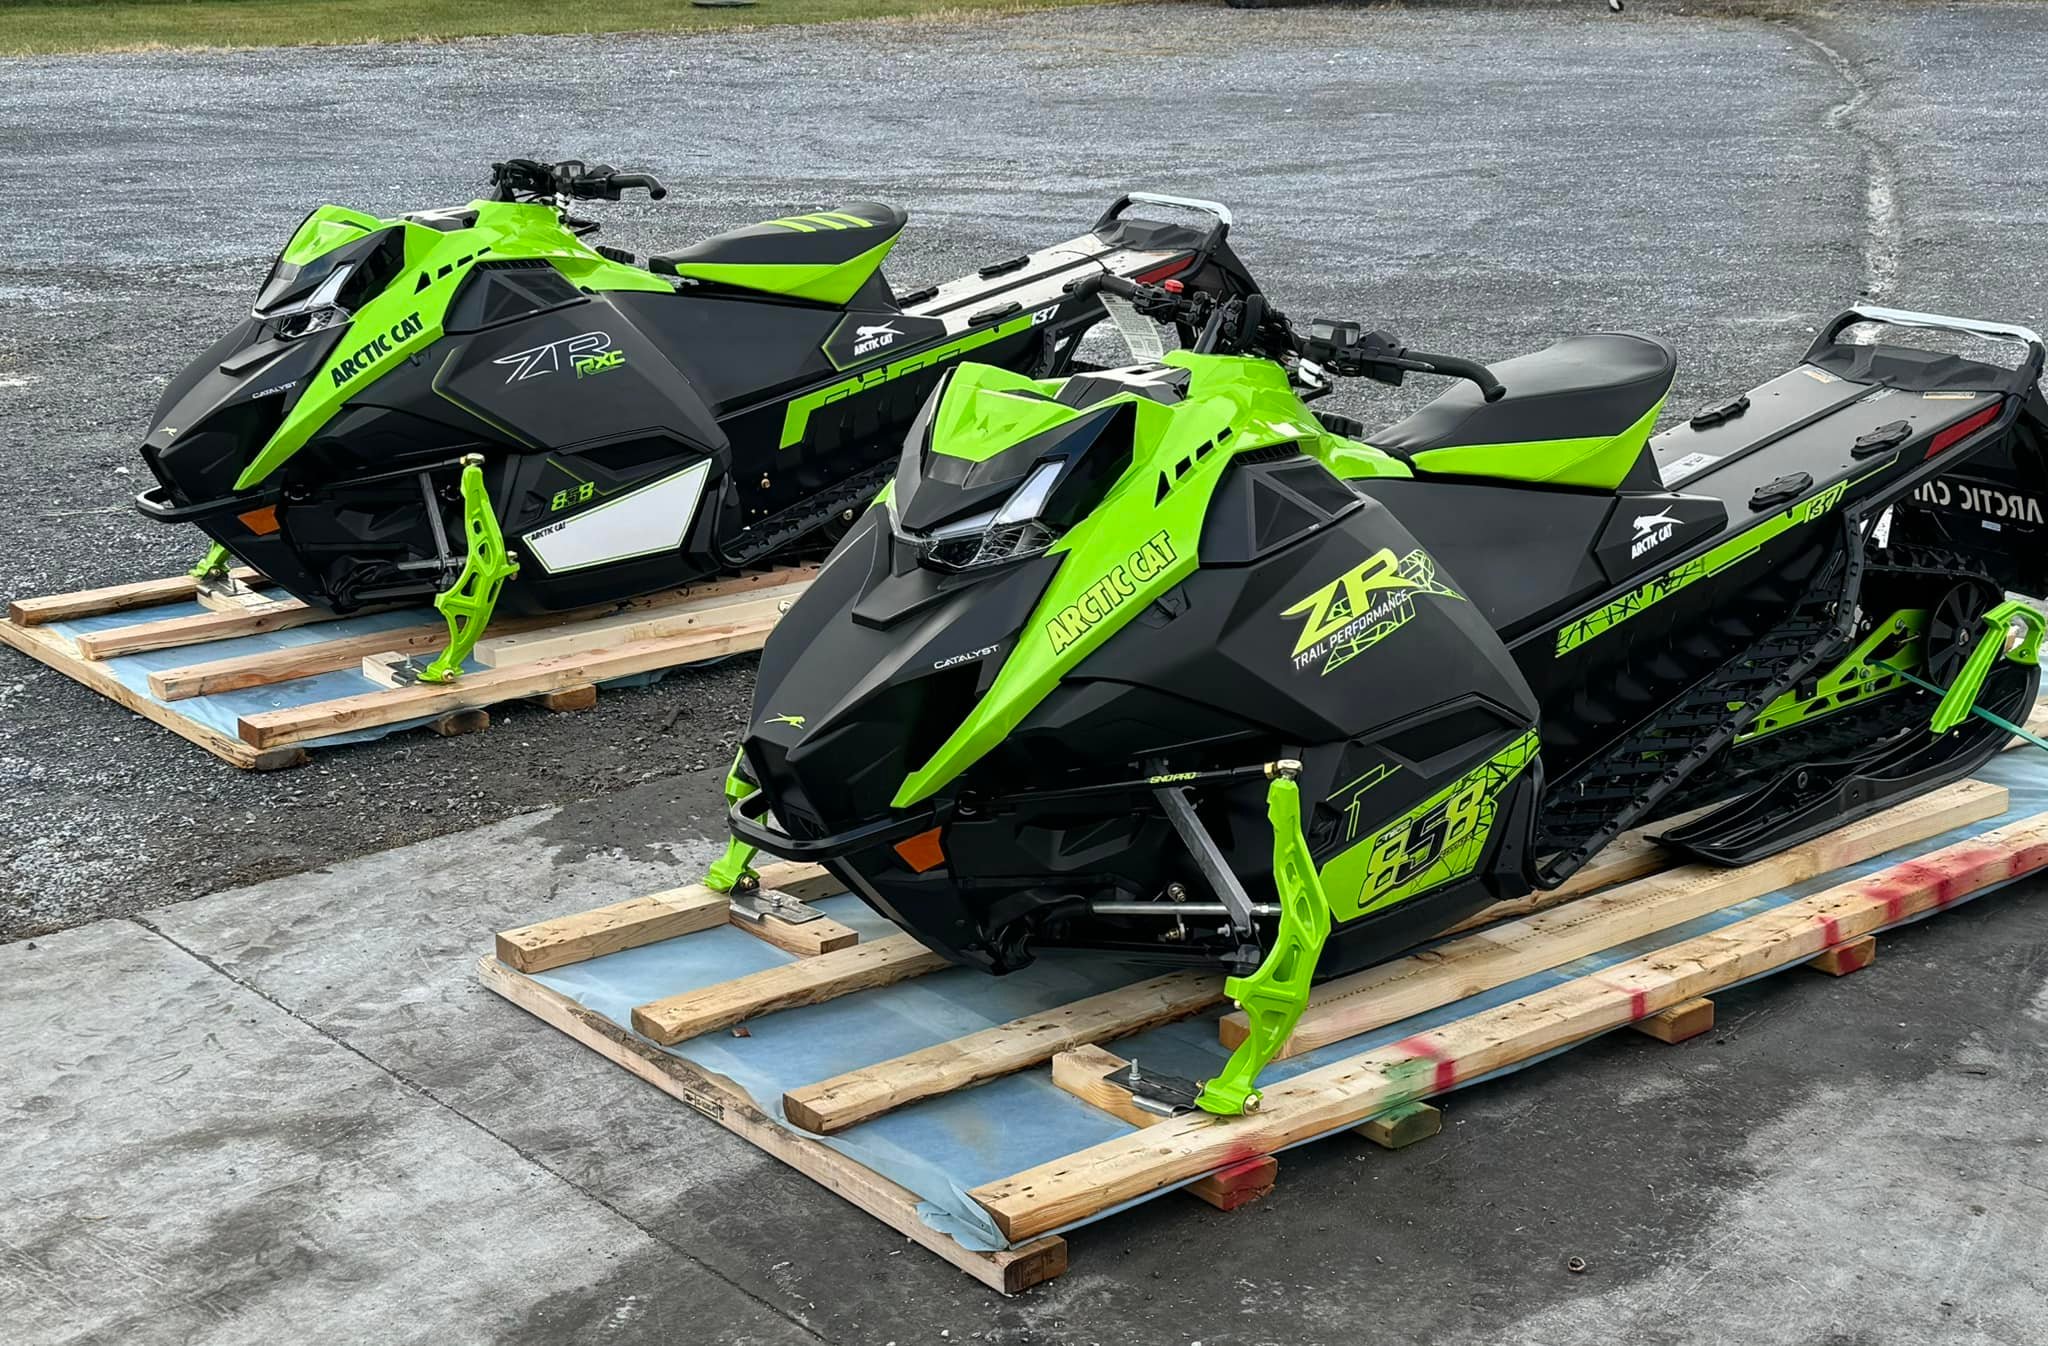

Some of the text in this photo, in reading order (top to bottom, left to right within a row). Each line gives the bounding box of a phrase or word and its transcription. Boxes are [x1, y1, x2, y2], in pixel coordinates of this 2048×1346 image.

[1031, 304, 1060, 326] 137
[331, 312, 424, 388] ARCTIC CAT
[493, 331, 611, 384] ZR
[854, 333, 893, 356] ARCTIC CAT
[576, 350, 625, 379] RXC
[252, 381, 297, 399] CATALYST
[531, 525, 554, 541] ARCTIC
[1632, 523, 1673, 559] ARCTIC CAT
[1045, 529, 1177, 655] ARCTIC CAT
[1280, 547, 1422, 658] ZR
[1293, 589, 1408, 670] TRAIL PERFORMANCE
[934, 644, 999, 669] CATALYST
[1358, 778, 1486, 908] 858
